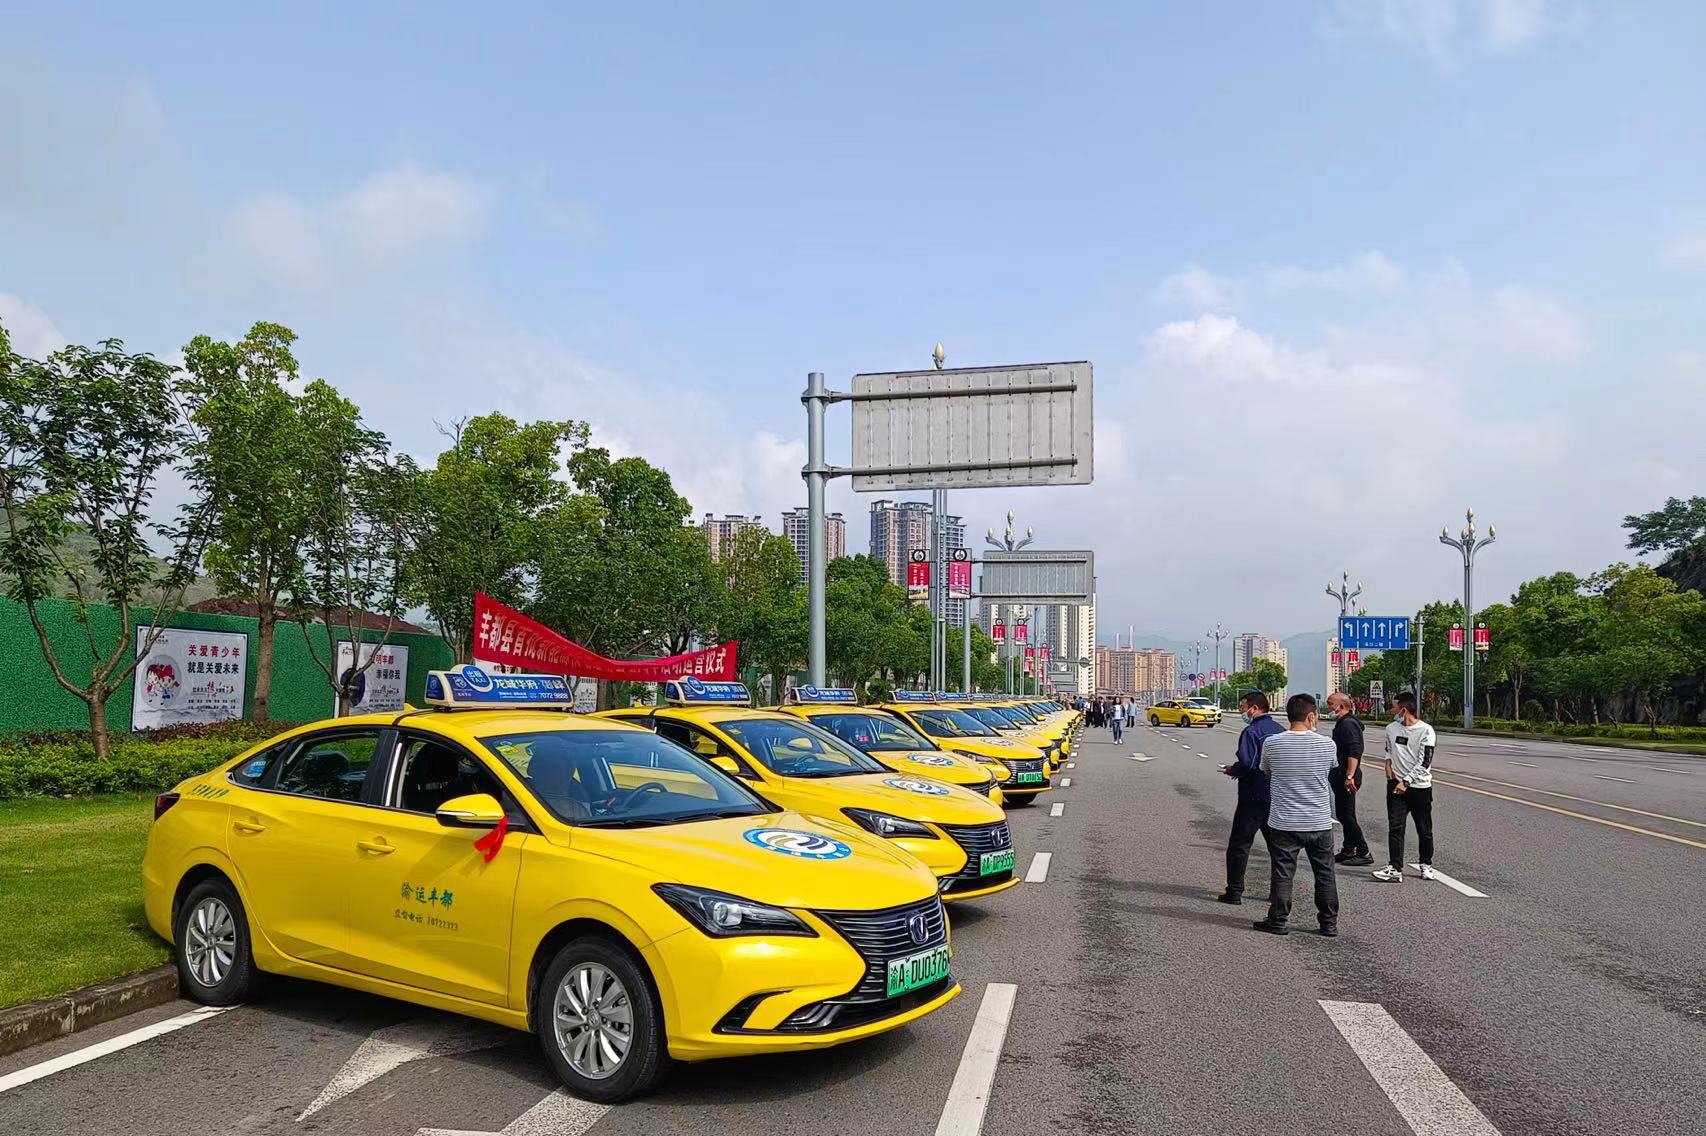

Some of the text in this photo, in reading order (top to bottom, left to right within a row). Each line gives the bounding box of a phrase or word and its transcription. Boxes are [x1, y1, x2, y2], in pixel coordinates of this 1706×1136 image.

[188, 644, 240, 658] 关爱青少年
[187, 661, 239, 675] 就是关爱未来
